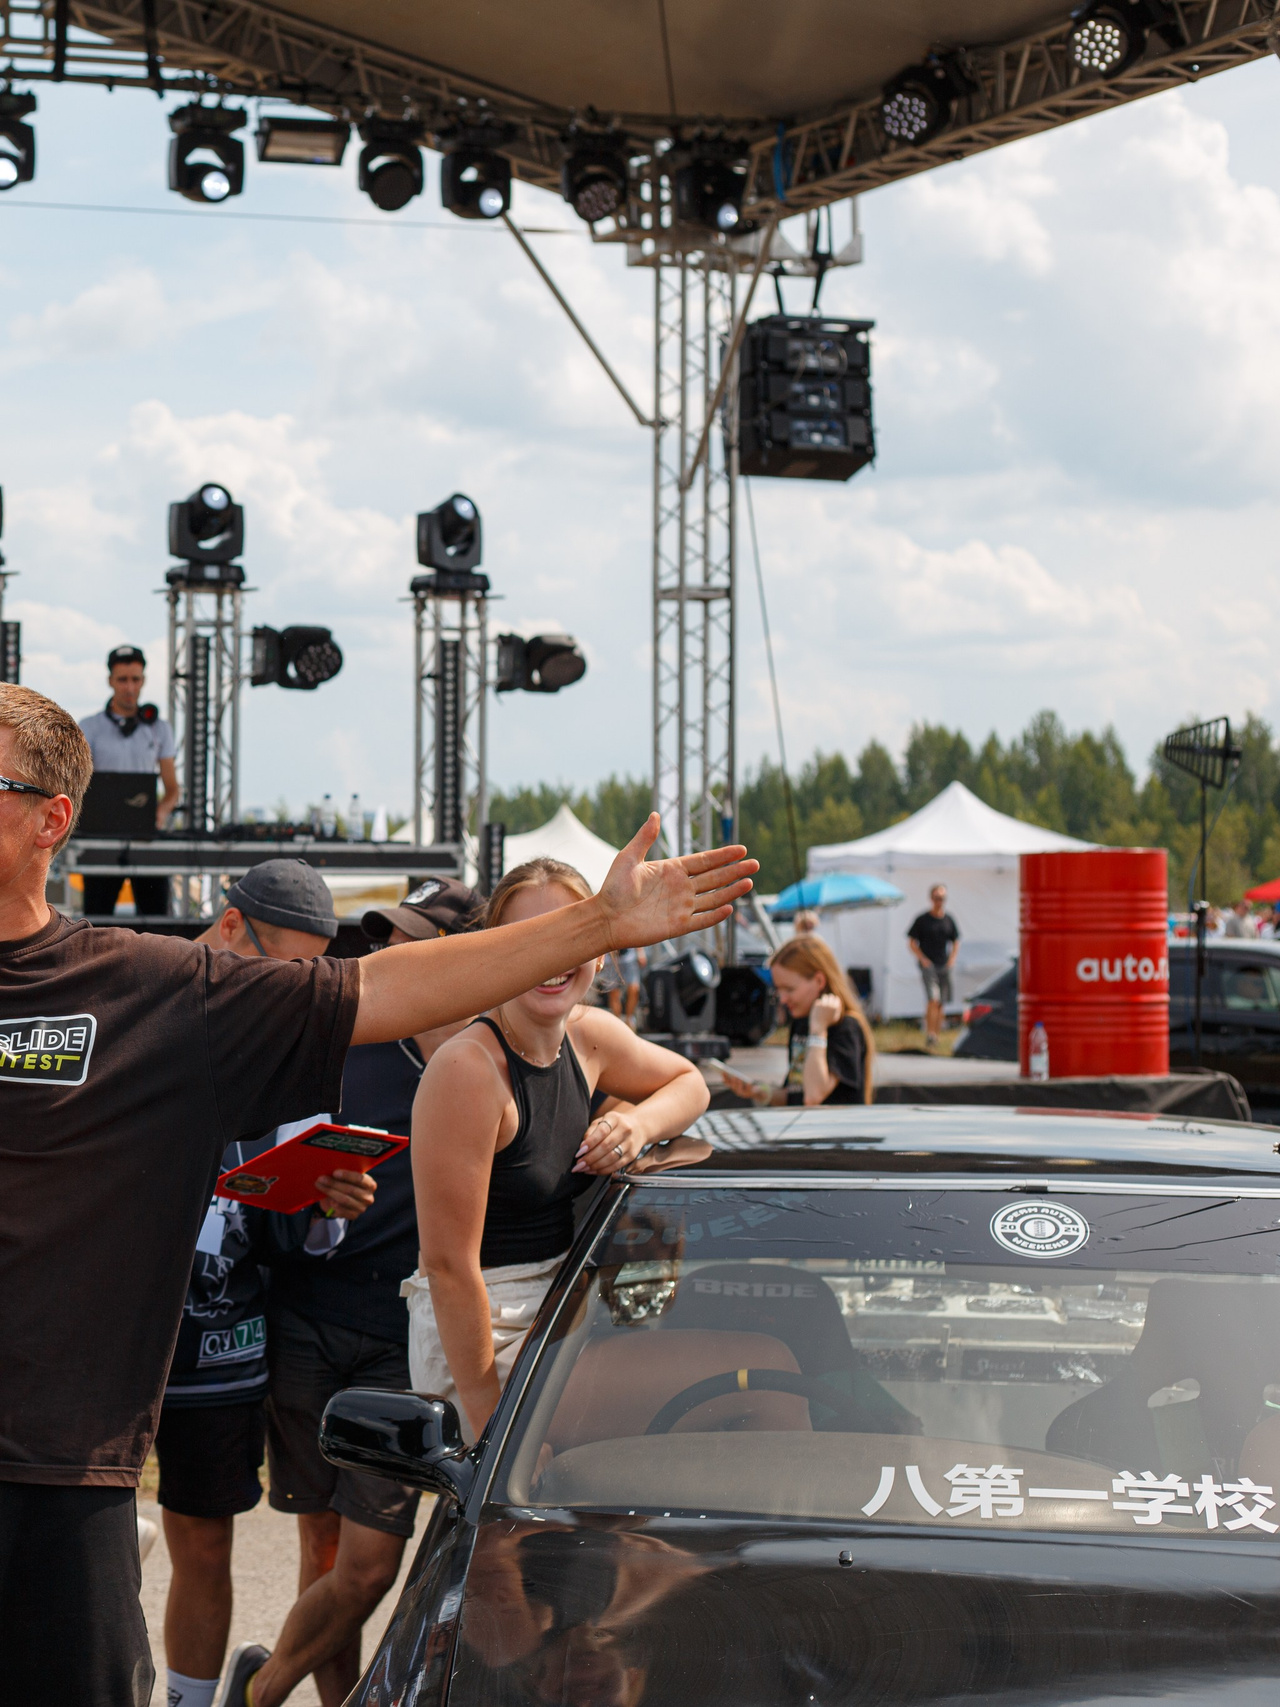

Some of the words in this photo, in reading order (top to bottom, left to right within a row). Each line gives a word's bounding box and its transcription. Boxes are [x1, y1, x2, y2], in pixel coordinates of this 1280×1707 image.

[1076, 953, 1169, 982] auto.r
[1006, 1207, 1038, 1222] PERM
[1040, 1208, 1073, 1224] AUTO
[1011, 1236, 1069, 1250] WEEKEND
[692, 1278, 819, 1299] BRIDE
[860, 1463, 1280, 1534] 八第一学校
